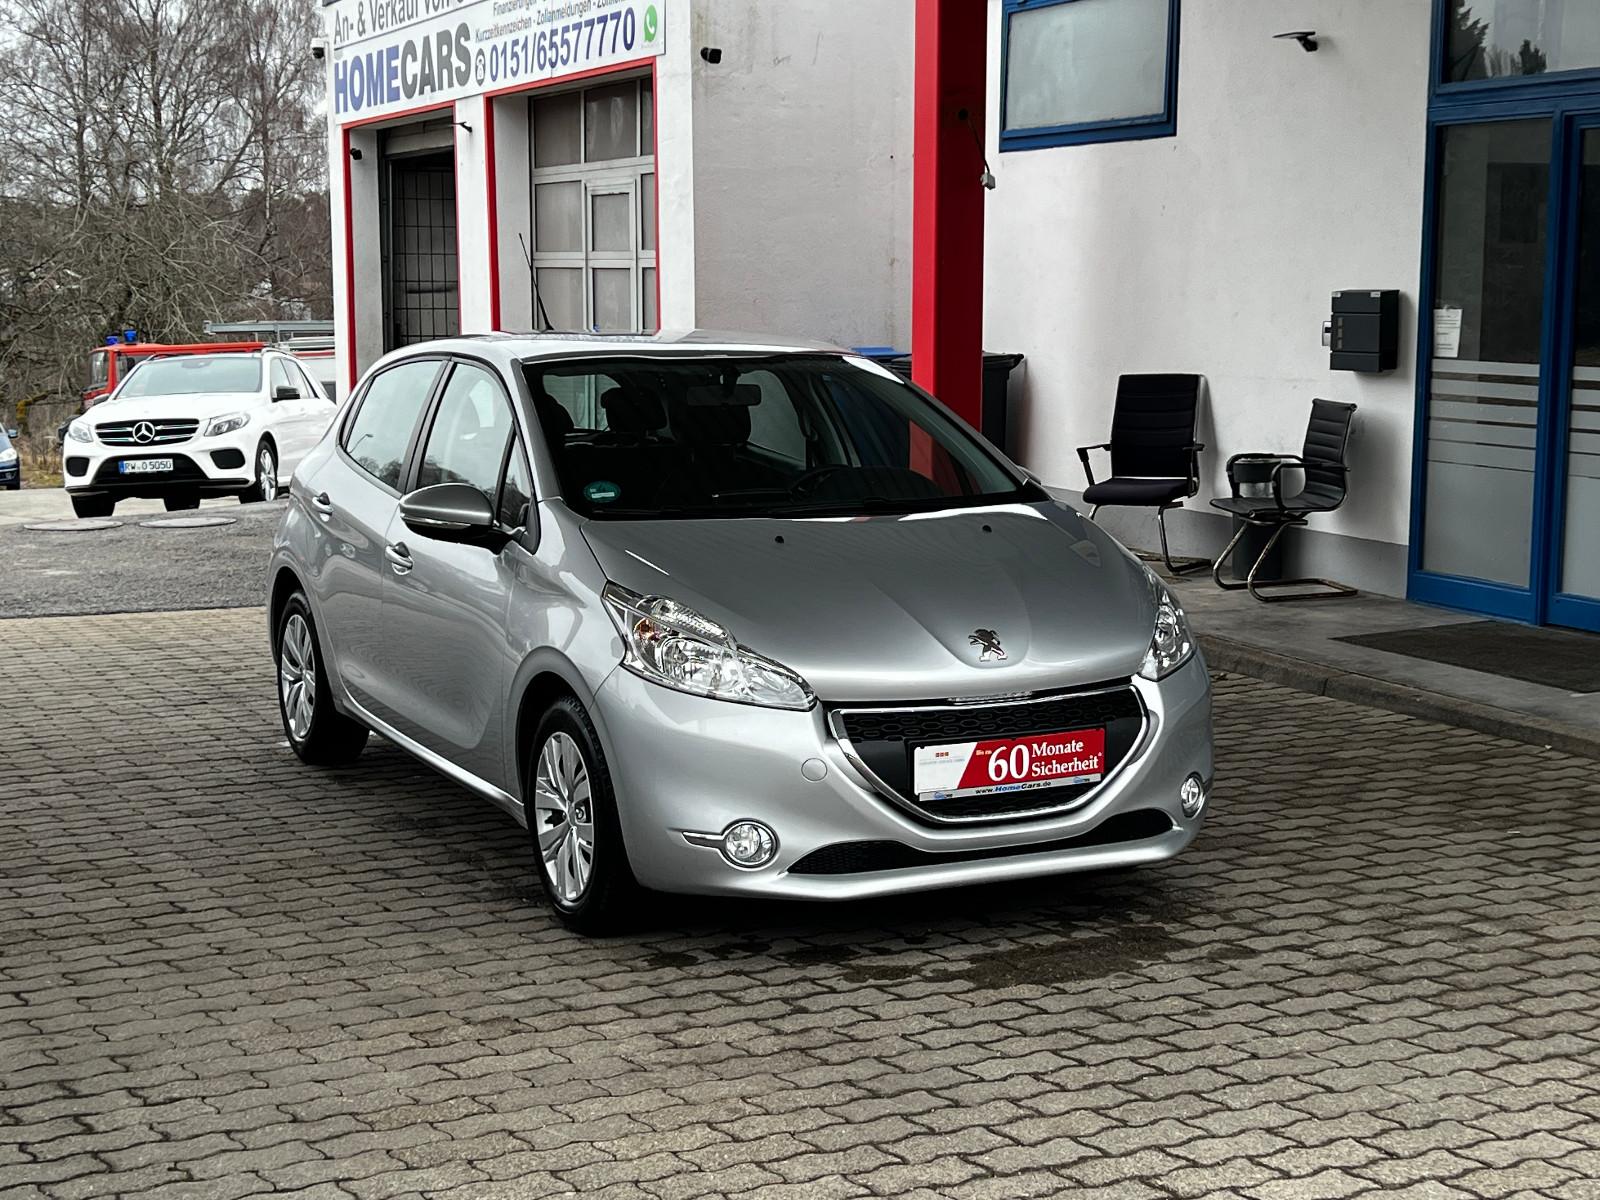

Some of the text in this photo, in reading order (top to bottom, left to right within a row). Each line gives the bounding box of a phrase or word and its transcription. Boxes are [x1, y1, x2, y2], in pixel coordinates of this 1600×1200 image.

[334, 10, 353, 45] An-
[357, 1, 366, 37] &
[490, 7, 635, 83] 0151/65577770
[334, 22, 472, 114] HOMECARS
[149, 460, 172, 470] 5050
[988, 744, 1030, 781] 60
[1031, 739, 1084, 758] Monate
[975, 781, 1052, 794] www.HomeCars.de
